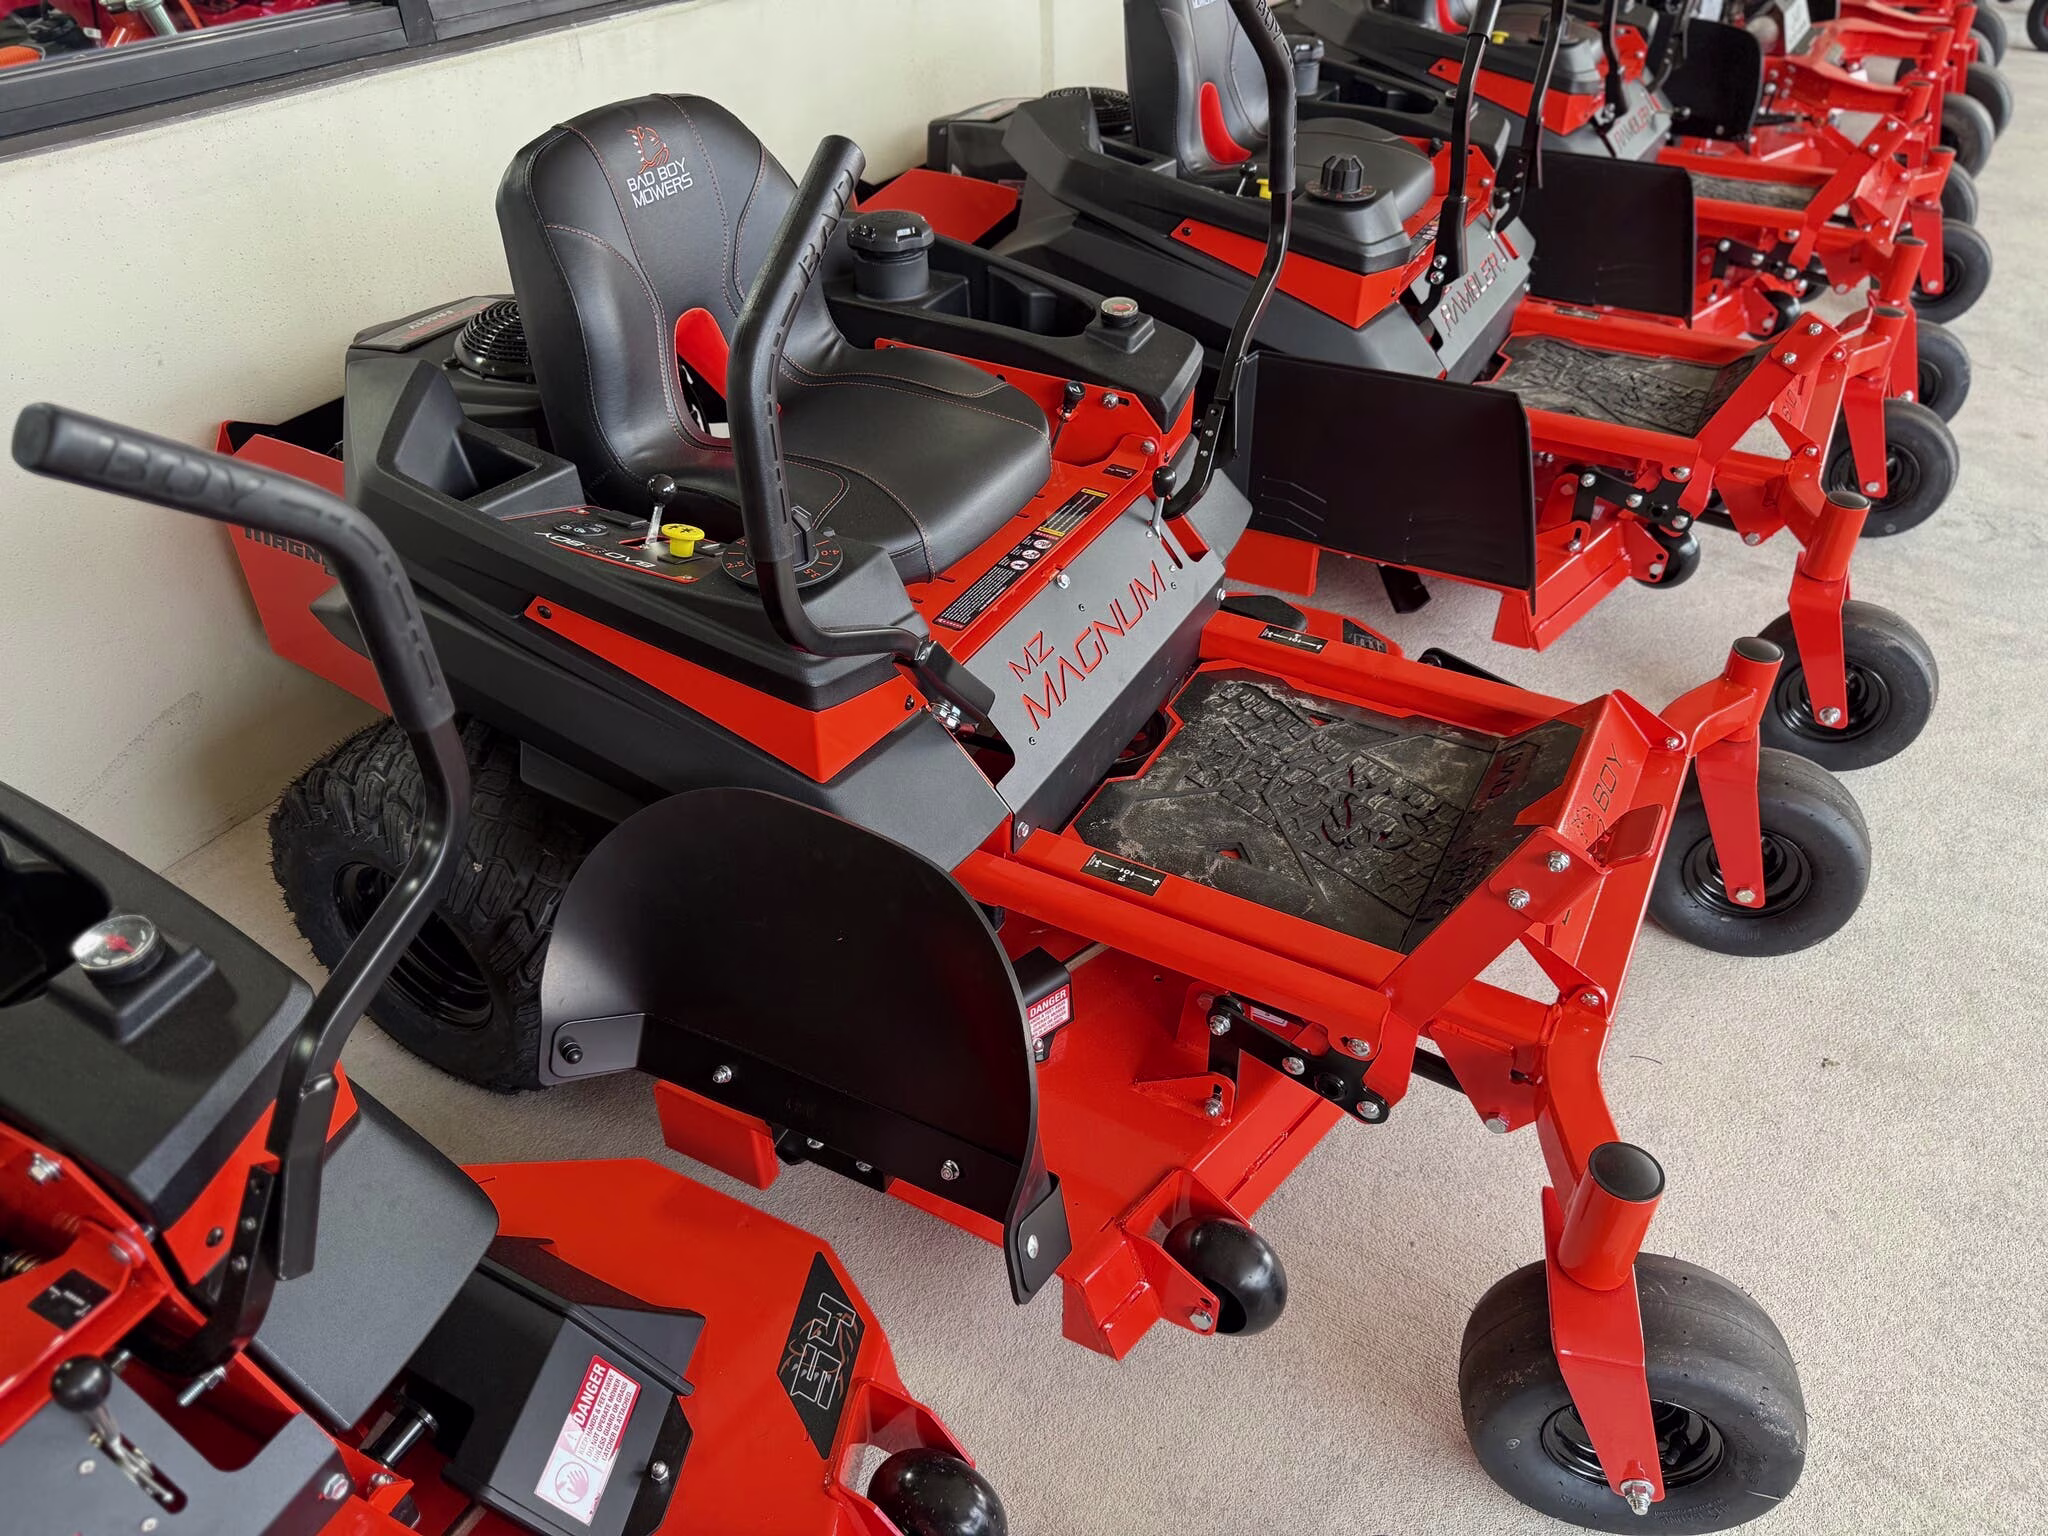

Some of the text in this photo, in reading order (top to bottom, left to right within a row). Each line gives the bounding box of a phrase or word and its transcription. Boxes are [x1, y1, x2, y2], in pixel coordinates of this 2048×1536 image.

[626, 156, 685, 192] BAD BOY
[631, 171, 694, 209] MOWERS
[533, 531, 657, 568] BAD BOY
[725, 560, 746, 570] 2.5
[1008, 630, 1056, 683] MZ
[1021, 559, 1167, 732] MAGNUM
[1592, 743, 1623, 813] BOY
[1029, 988, 1067, 1018] DANGER
[790, 1292, 857, 1410] 54
[573, 1362, 606, 1426] DANGER
[585, 1414, 598, 1437] HANDS
[597, 1392, 607, 1408] FEET
[590, 1432, 600, 1446] NOT
[595, 1403, 612, 1432] OPERATE
[607, 1379, 622, 1403] MOWER
[591, 1436, 607, 1462] UNLESS
[602, 1414, 615, 1436] GUARD
[615, 1382, 628, 1403] GRASS
[600, 1432, 617, 1461] CATCHER
